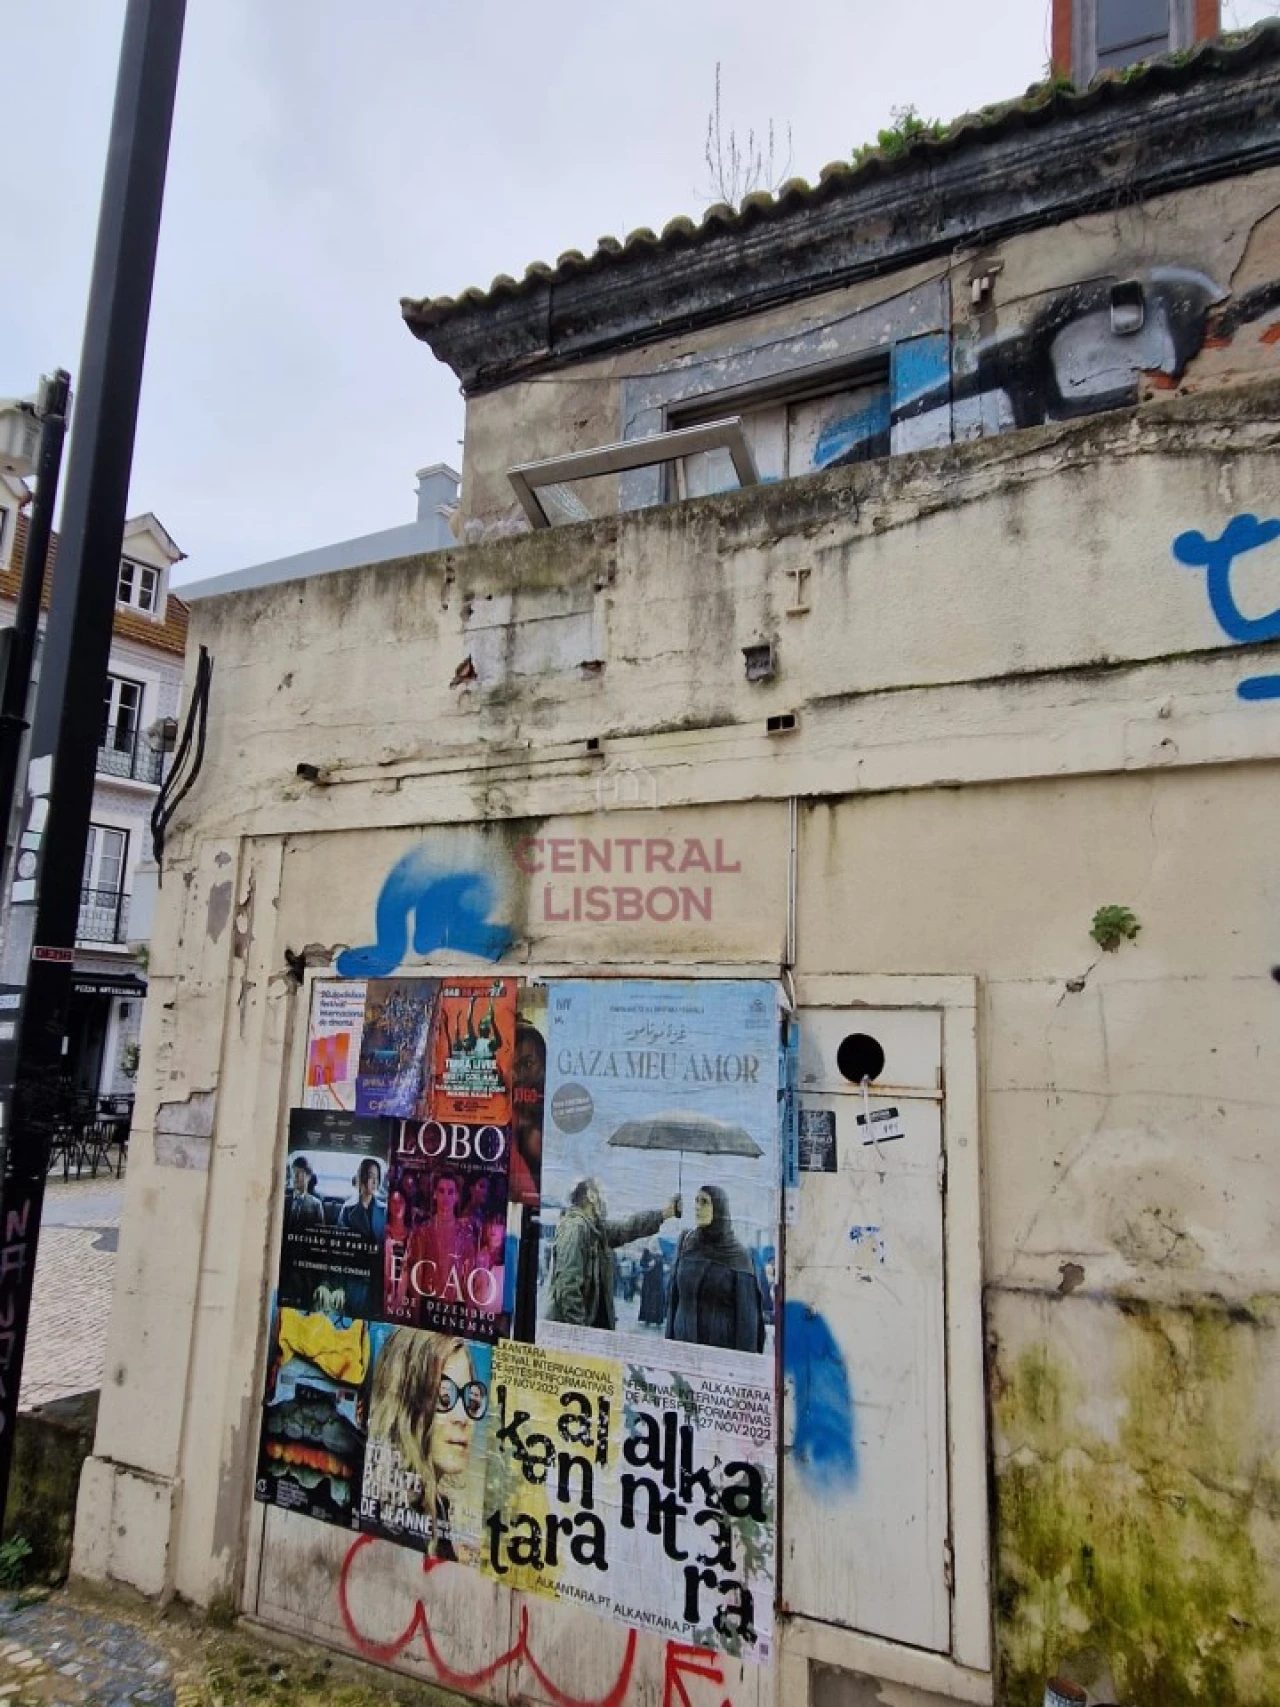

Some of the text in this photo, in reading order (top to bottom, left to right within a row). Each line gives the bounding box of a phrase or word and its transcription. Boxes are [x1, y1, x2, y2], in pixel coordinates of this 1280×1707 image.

[557, 1049, 760, 1083] GAZA MEU AMOR
[396, 1120, 506, 1162] LOBO
[410, 1253, 498, 1306] CÃO
[387, 1306, 495, 1336] NOS CINEMAS
[426, 1301, 496, 1322] DEZEMBRO
[497, 1341, 547, 1359] LKANTARA
[514, 1377, 536, 1390] NOV
[536, 1382, 559, 1396] 2022
[533, 1359, 612, 1384] INTERNACIONAL
[679, 1388, 771, 1415] INTERNACIONAL
[701, 1380, 771, 1402] ALKANTARA
[625, 1390, 772, 1427] DE ARTES PERFORMATIVAS
[714, 1420, 740, 1434] NOV
[742, 1425, 771, 1440] 2022
[361, 1498, 377, 1518] DE
[381, 1505, 433, 1535] JEANNE
[486, 1509, 608, 1574] tara
[536, 1576, 611, 1607] ALKANTARA.PT
[612, 1603, 698, 1635] ALKANTARA.PT
